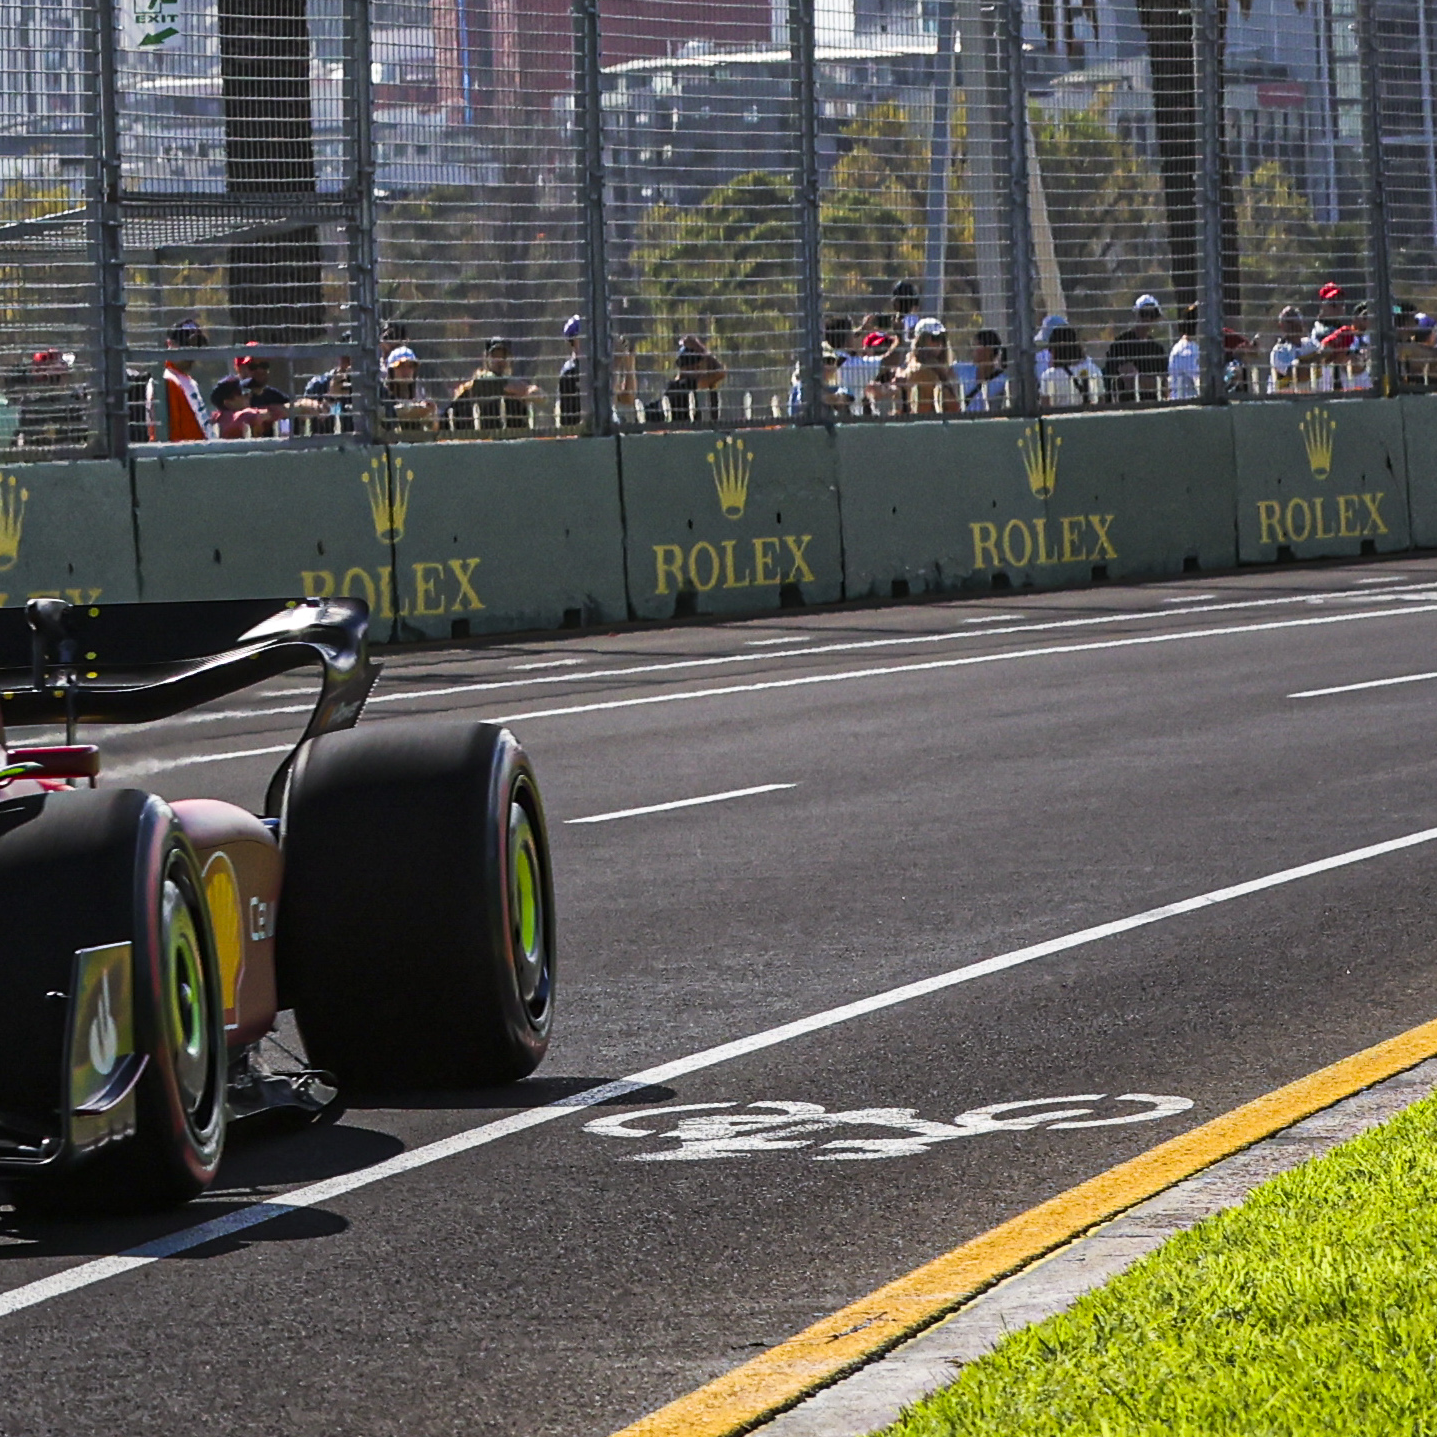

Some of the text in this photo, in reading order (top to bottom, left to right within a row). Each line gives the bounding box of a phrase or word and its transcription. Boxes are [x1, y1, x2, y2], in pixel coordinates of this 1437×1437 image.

[135, 14, 178, 24] EXIT
[969, 514, 1118, 570] ROLEX
[1257, 493, 1389, 545] ROLEX
[652, 534, 816, 595] ROLEX
